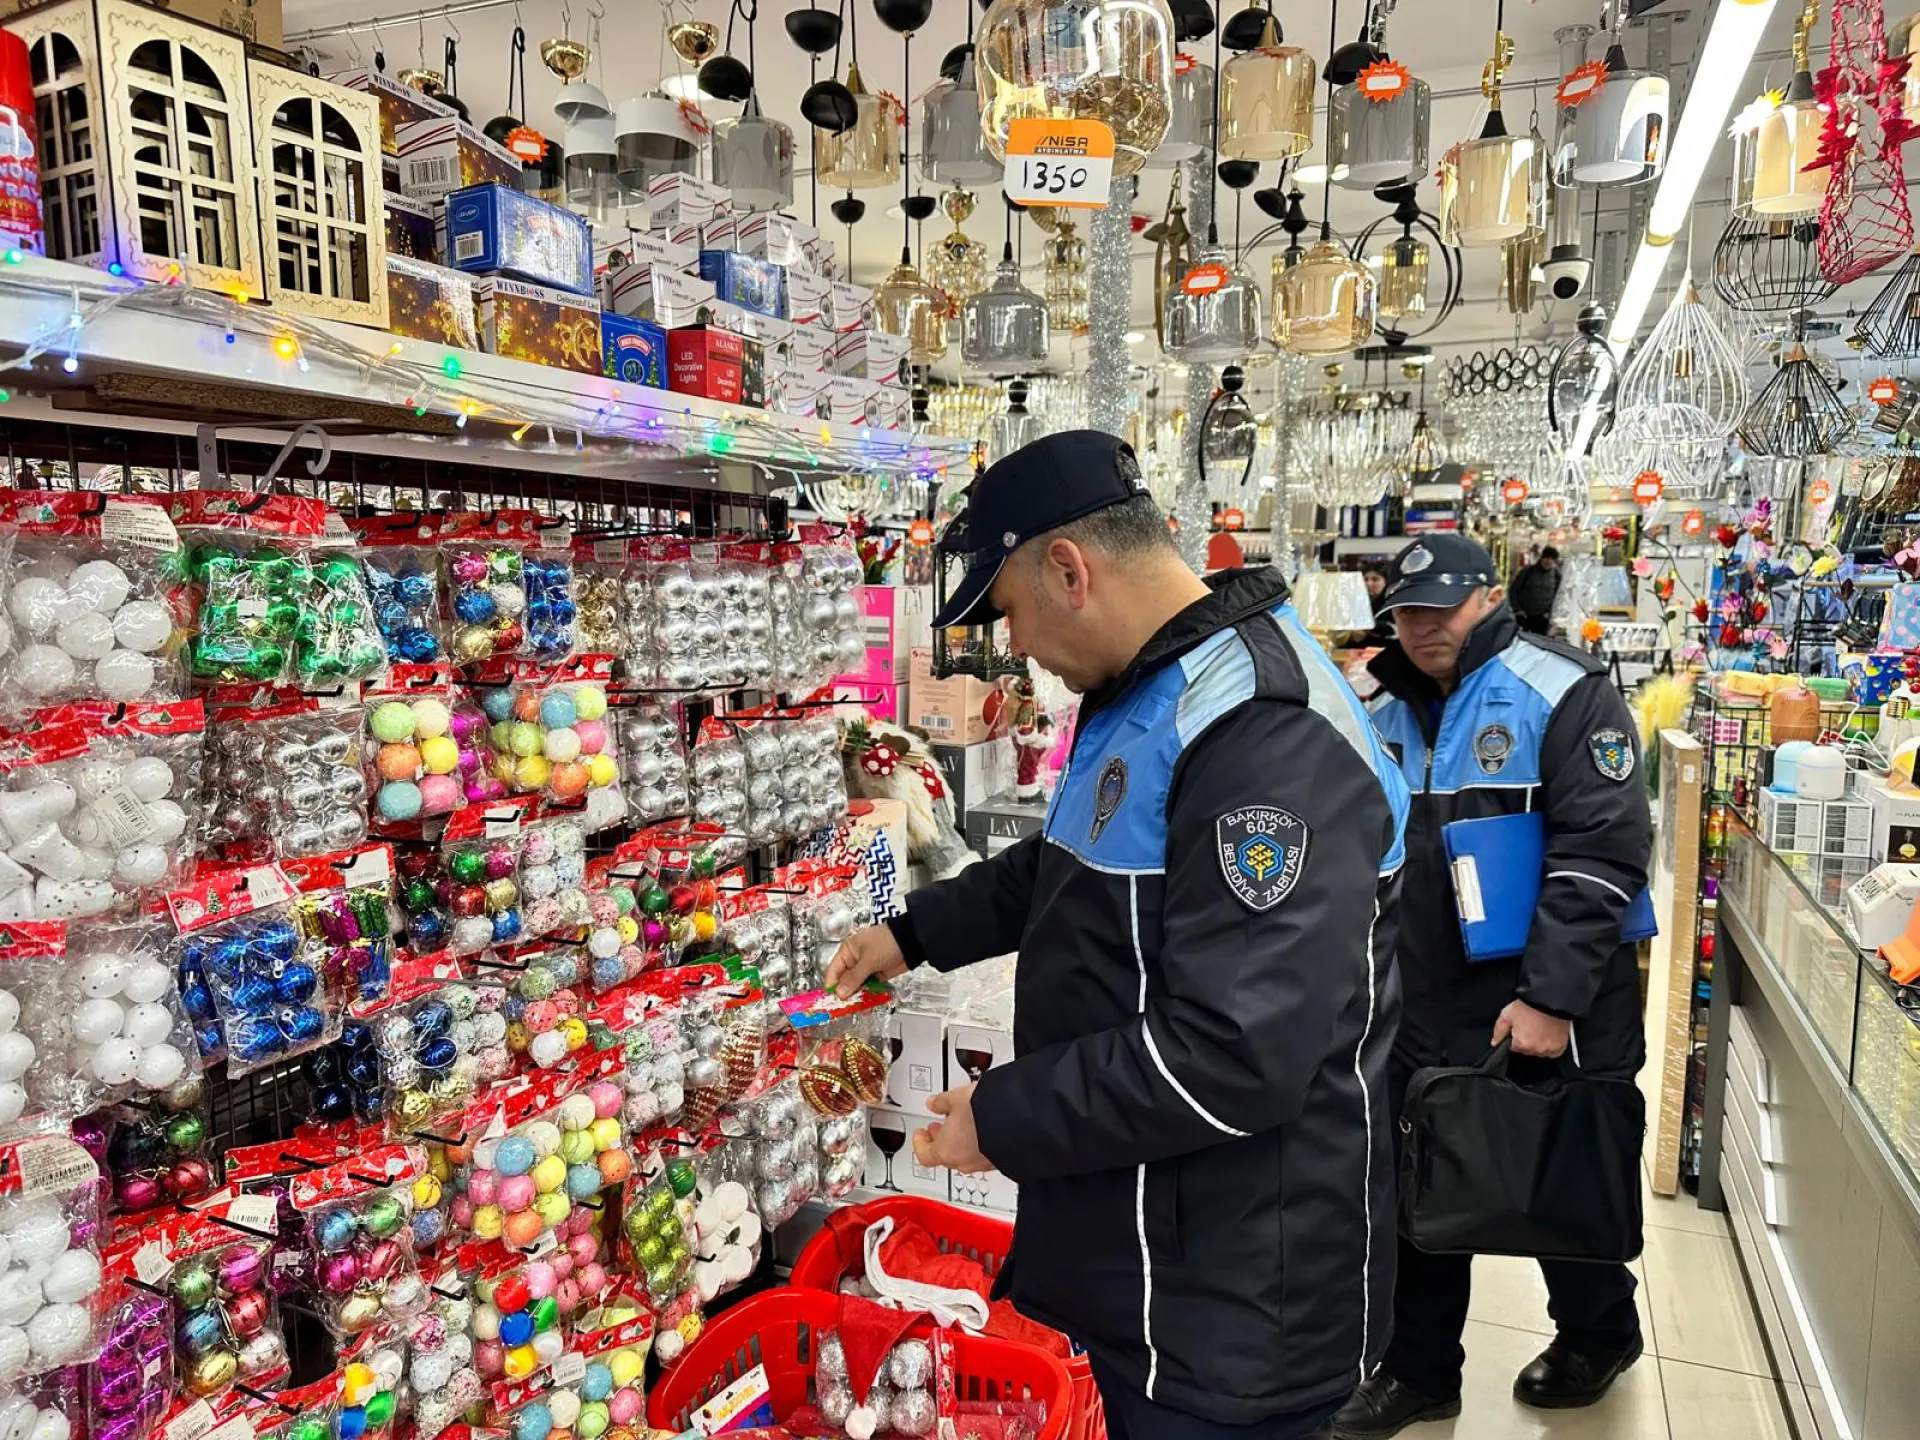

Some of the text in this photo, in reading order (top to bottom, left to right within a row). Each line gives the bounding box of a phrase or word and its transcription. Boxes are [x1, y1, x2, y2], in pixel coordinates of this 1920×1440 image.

[0, 163, 37, 184] NOW
[1023, 160, 1088, 194] 1350
[496, 279, 546, 299] WINNBOSS
[715, 338, 739, 352] ALASKA
[681, 351, 694, 361] LED
[674, 362, 704, 373] Decorative
[679, 373, 698, 384] Lights
[990, 817, 1023, 836] LAV
[1225, 810, 1297, 829] BAKIRKÖY
[1246, 820, 1278, 835] 602
[1223, 843, 1258, 901] BELEDİYE
[1262, 845, 1301, 902] ZABITASI
